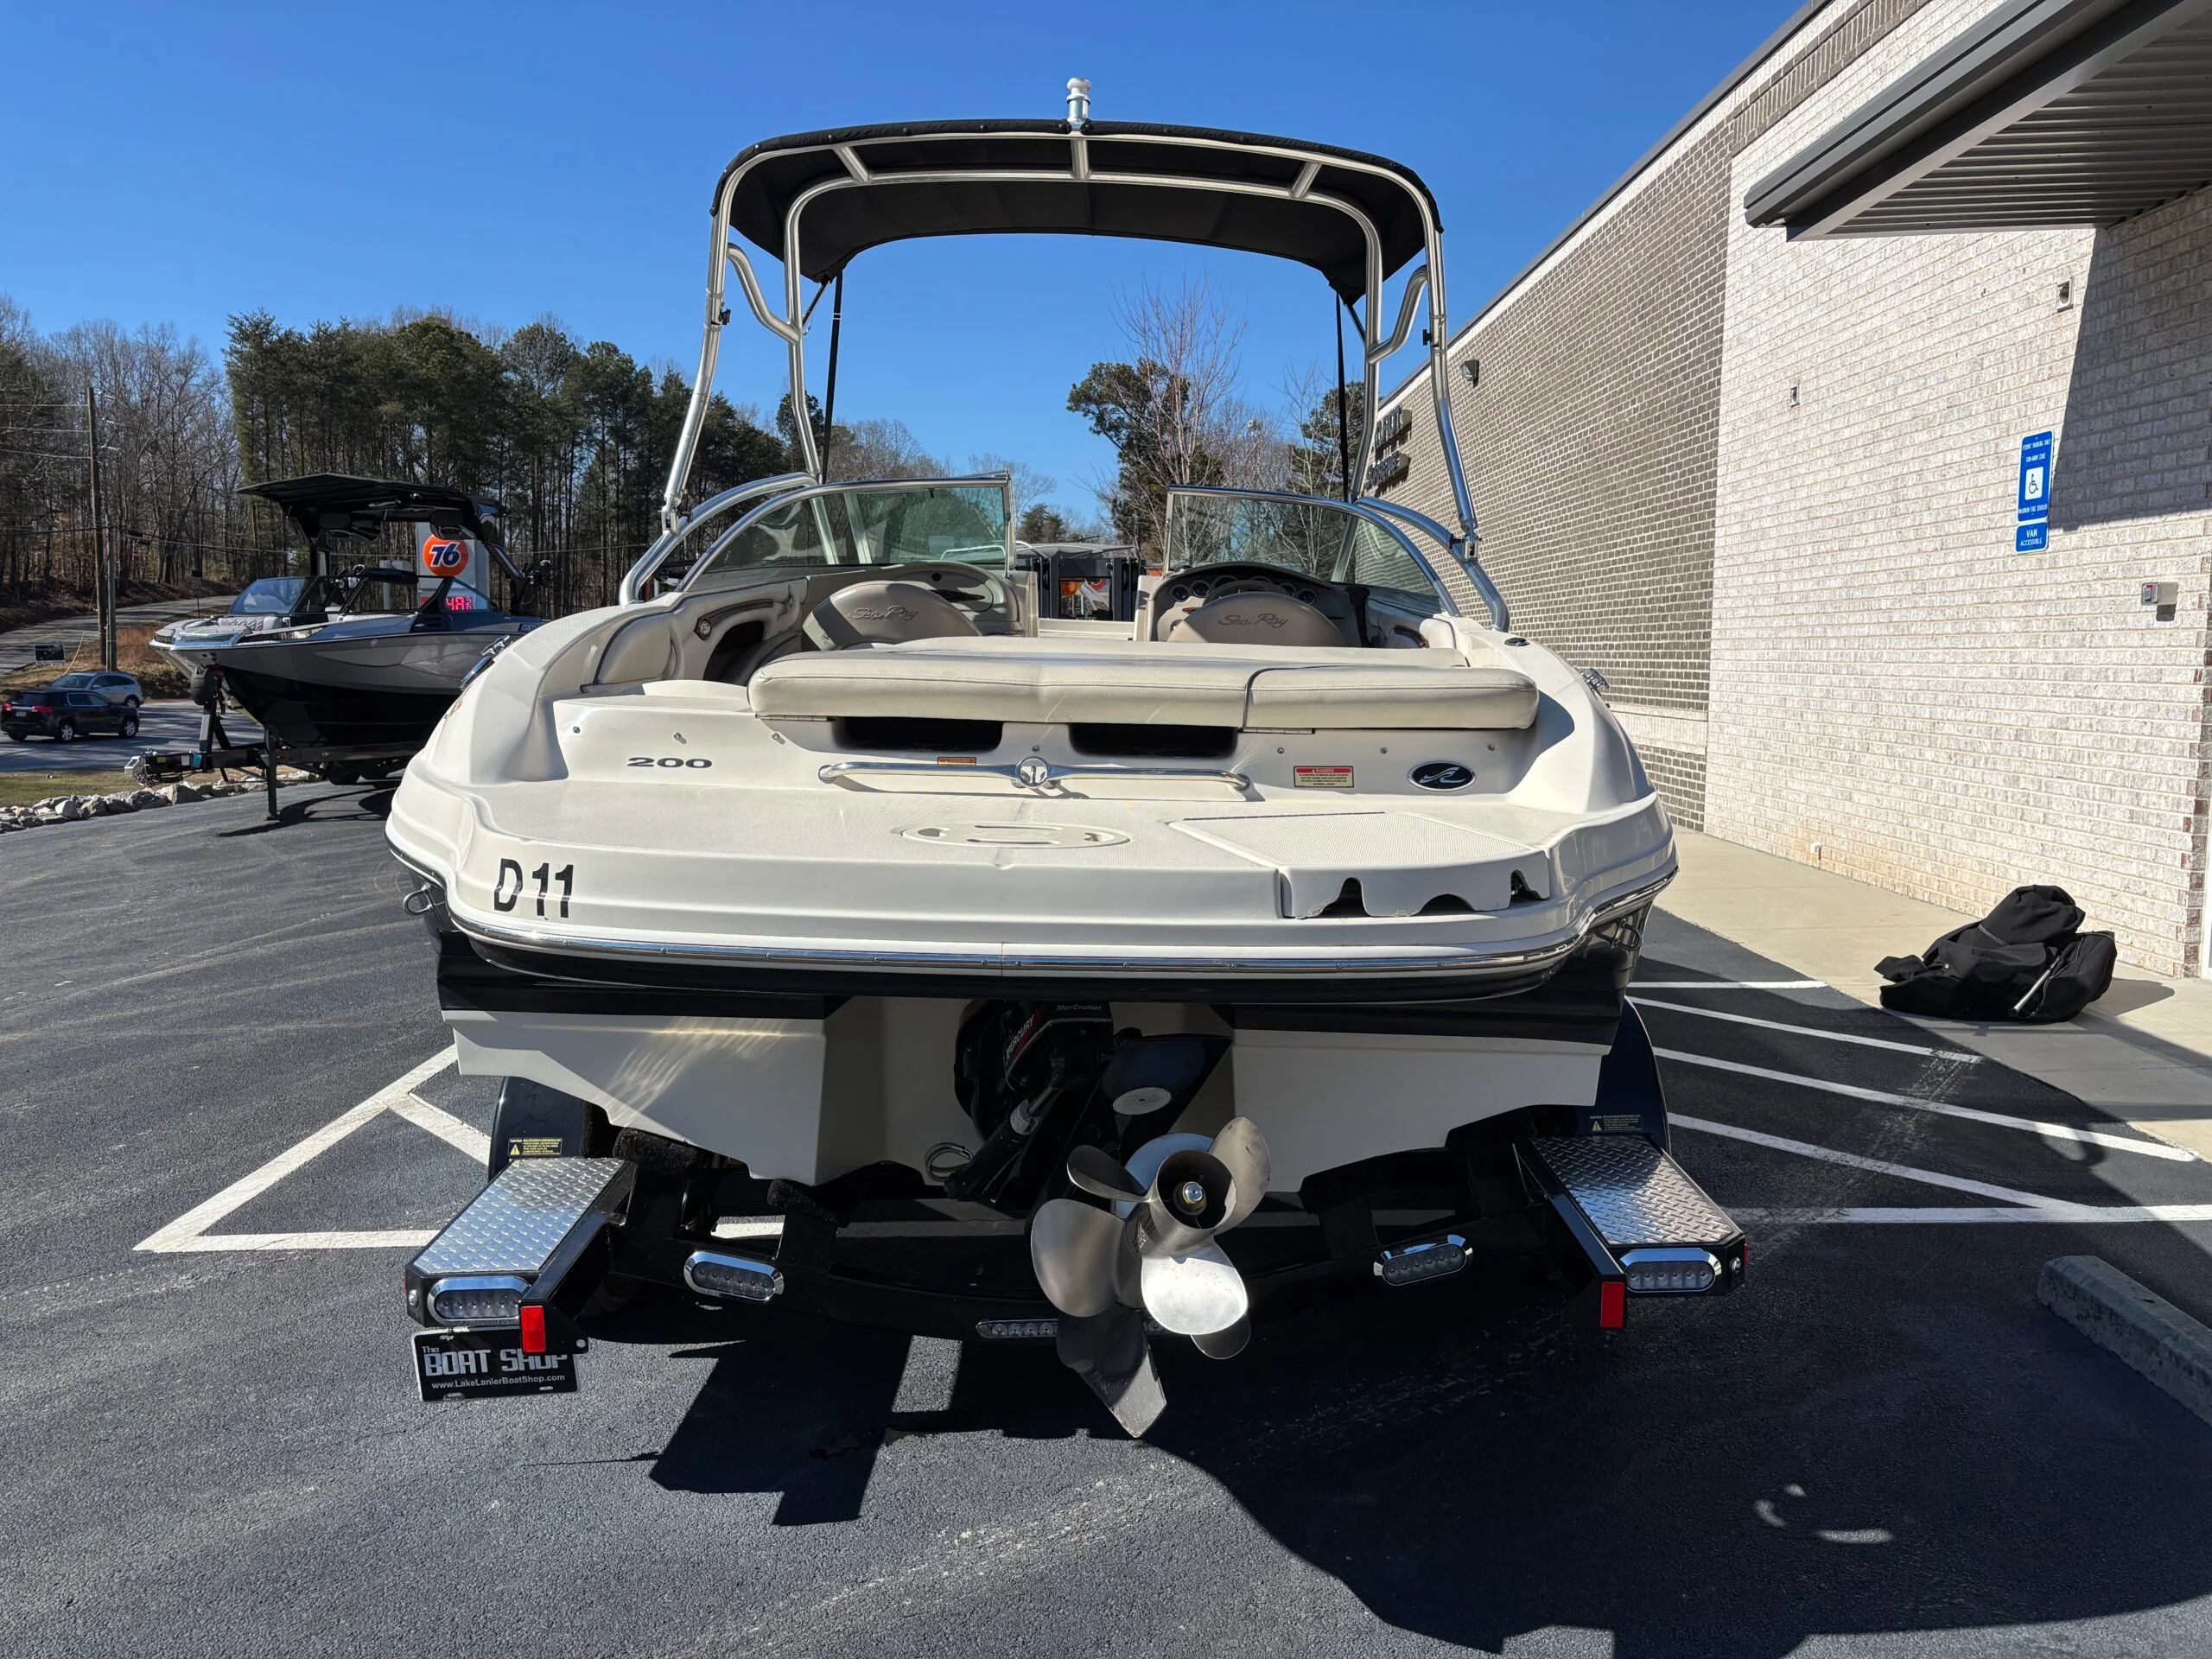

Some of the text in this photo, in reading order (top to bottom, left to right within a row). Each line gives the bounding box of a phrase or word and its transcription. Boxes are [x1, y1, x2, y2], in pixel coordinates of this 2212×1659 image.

[2026, 528, 2038, 538] VAN
[2019, 537, 2043, 546] ACCESSIBLE
[429, 542, 461, 567] 76
[849, 605, 918, 621] Sea Ray
[1217, 613, 1289, 629] Sea Ray
[627, 757, 713, 768] 200
[1005, 1014, 1034, 1067] MERCURY
[424, 1349, 492, 1376] BOAT
[432, 1375, 565, 1389] www.LakeLanierBoatShop.com
